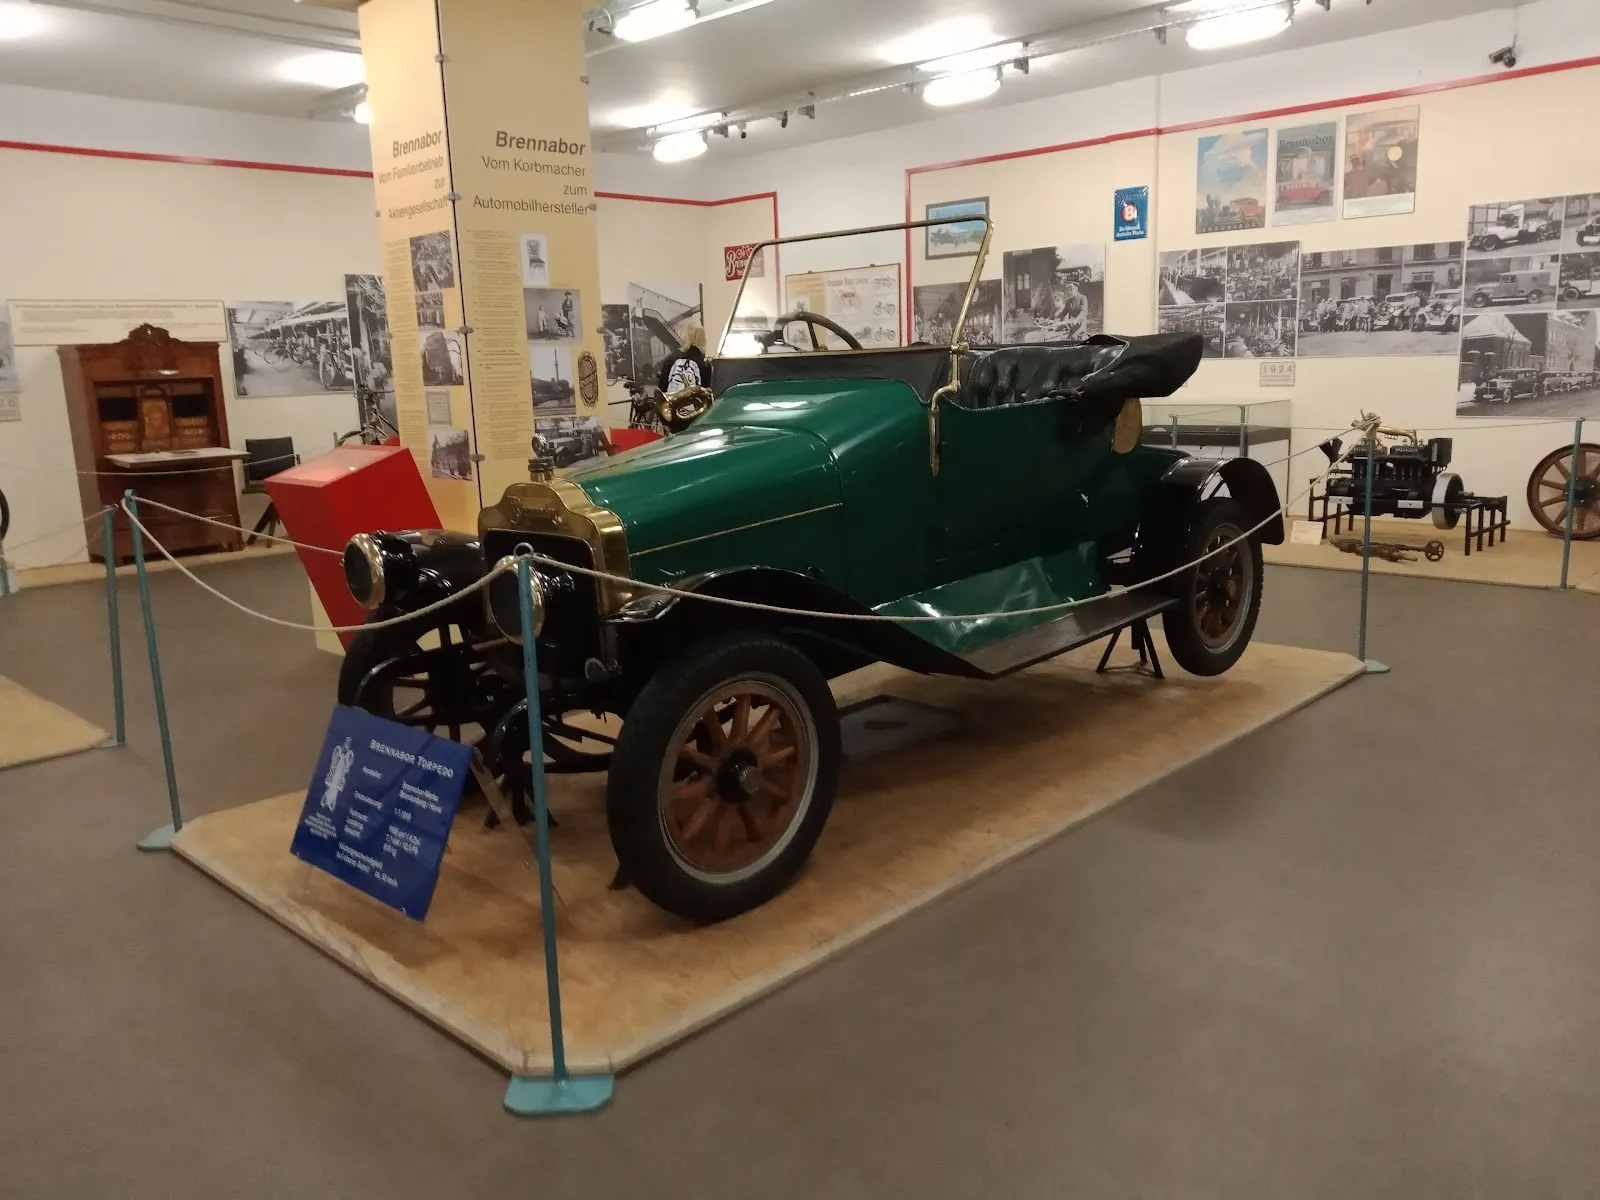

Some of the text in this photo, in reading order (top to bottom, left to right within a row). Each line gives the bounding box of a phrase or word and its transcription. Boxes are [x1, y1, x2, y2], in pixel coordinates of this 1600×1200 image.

[392, 130, 442, 158] Brennabor
[495, 130, 586, 156] Brennabor
[1279, 135, 1333, 150] Brennabor
[377, 155, 444, 184] Vom Familienbetrieb
[481, 155, 586, 177] Vom Korbmacher
[434, 176, 446, 189] zur
[563, 184, 587, 196] zum
[388, 195, 448, 220] Aktiengesellschaft
[473, 195, 588, 215] Automobilhersteller
[1263, 364, 1293, 374] 1924
[369, 738, 455, 778] BRENNABOR TORPEDO
